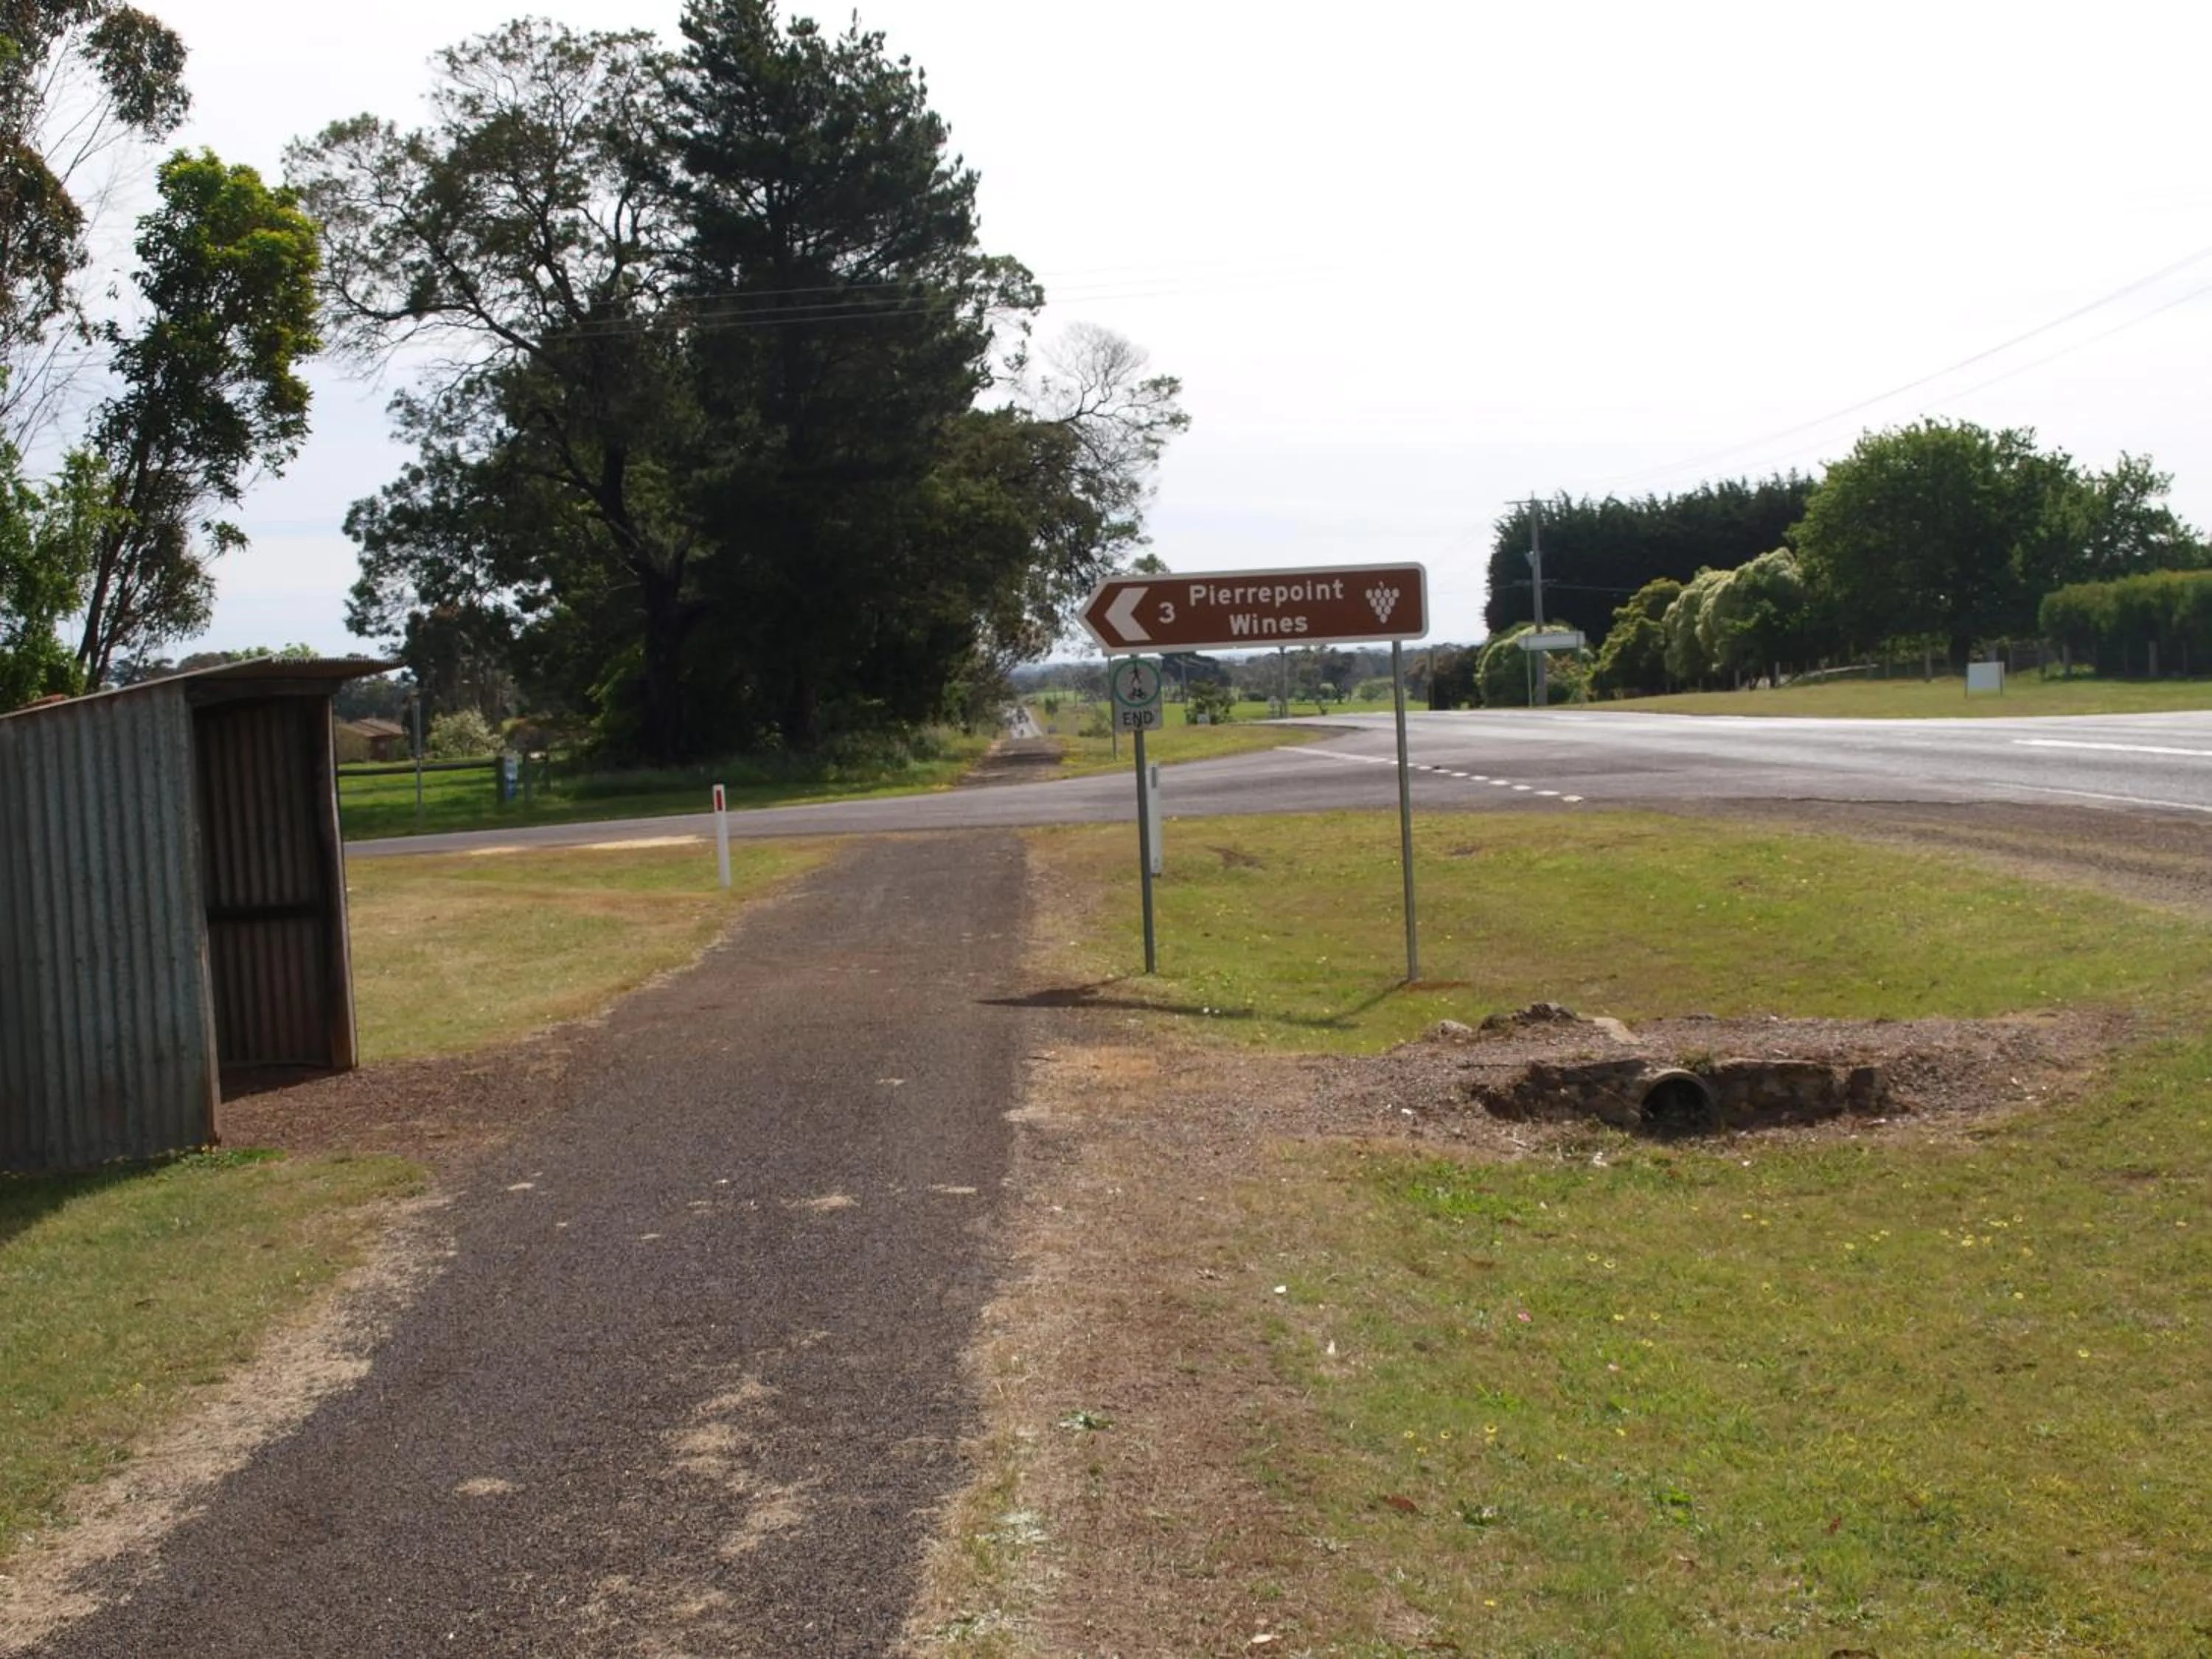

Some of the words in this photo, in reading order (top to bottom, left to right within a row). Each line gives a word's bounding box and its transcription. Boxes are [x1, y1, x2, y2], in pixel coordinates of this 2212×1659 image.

[1189, 578, 1343, 607] Pierrepoint
[1158, 602, 1176, 624] 3
[1229, 613, 1309, 636] Wines
[1122, 710, 1154, 726] END
